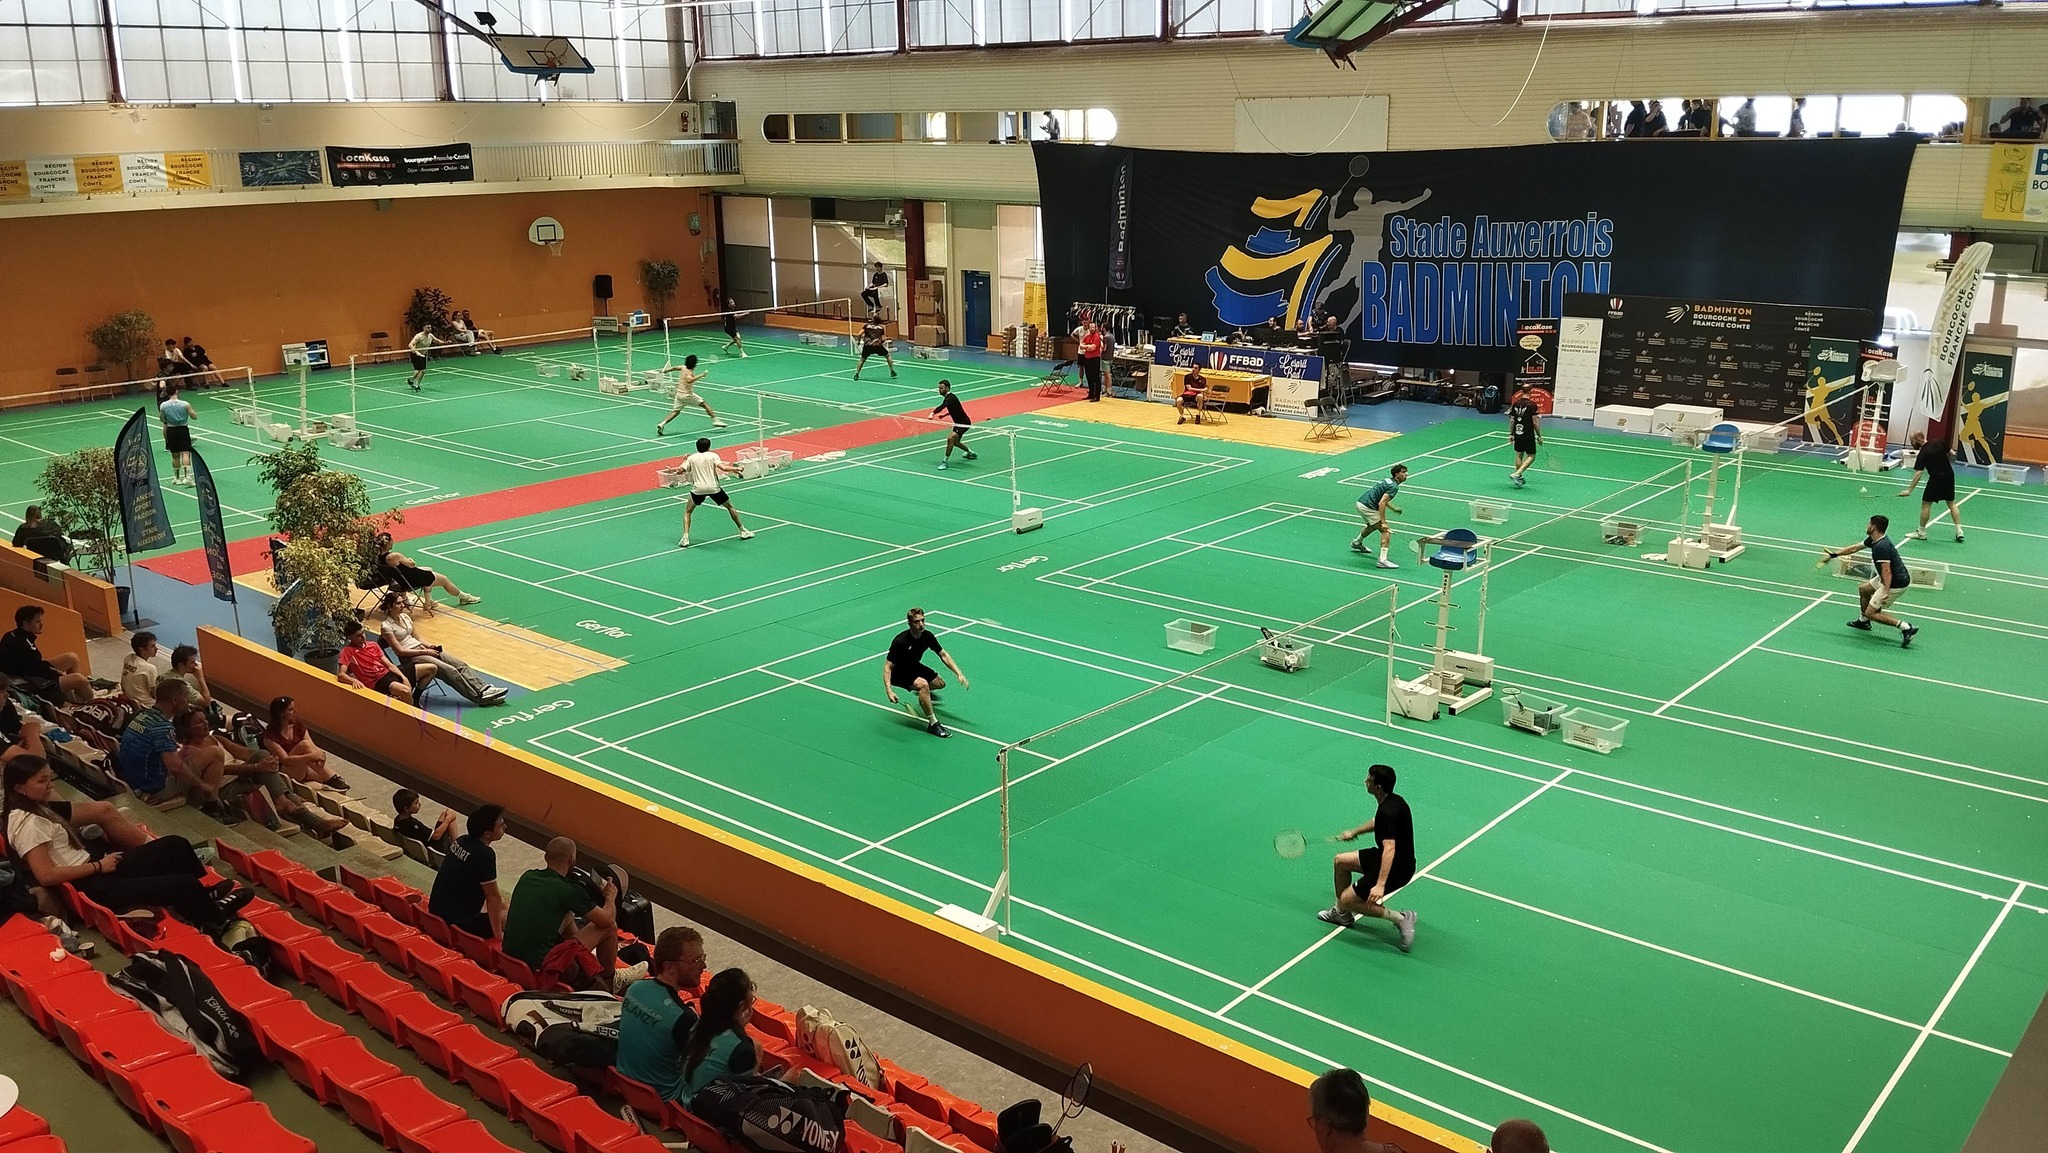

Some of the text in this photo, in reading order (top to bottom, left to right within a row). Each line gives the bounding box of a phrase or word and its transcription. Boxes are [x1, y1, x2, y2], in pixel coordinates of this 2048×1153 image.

[340, 153, 390, 162] LocaKase
[1390, 212, 1614, 259] Stade Auxerrois
[1693, 313, 1737, 322] BOURGOGNE
[1694, 304, 1752, 316] BADMINTON
[1692, 320, 1725, 328] FRANCHE
[1940, 288, 1967, 361] BOURGOGNE
[1947, 311, 1968, 366] FRANCHE
[1865, 347, 1894, 357] LocaKase
[575, 619, 633, 639] Gerflor
[490, 700, 575, 729] Gerflor
[203, 996, 229, 1020] YONEX
[801, 1117, 840, 1152] YONEX
